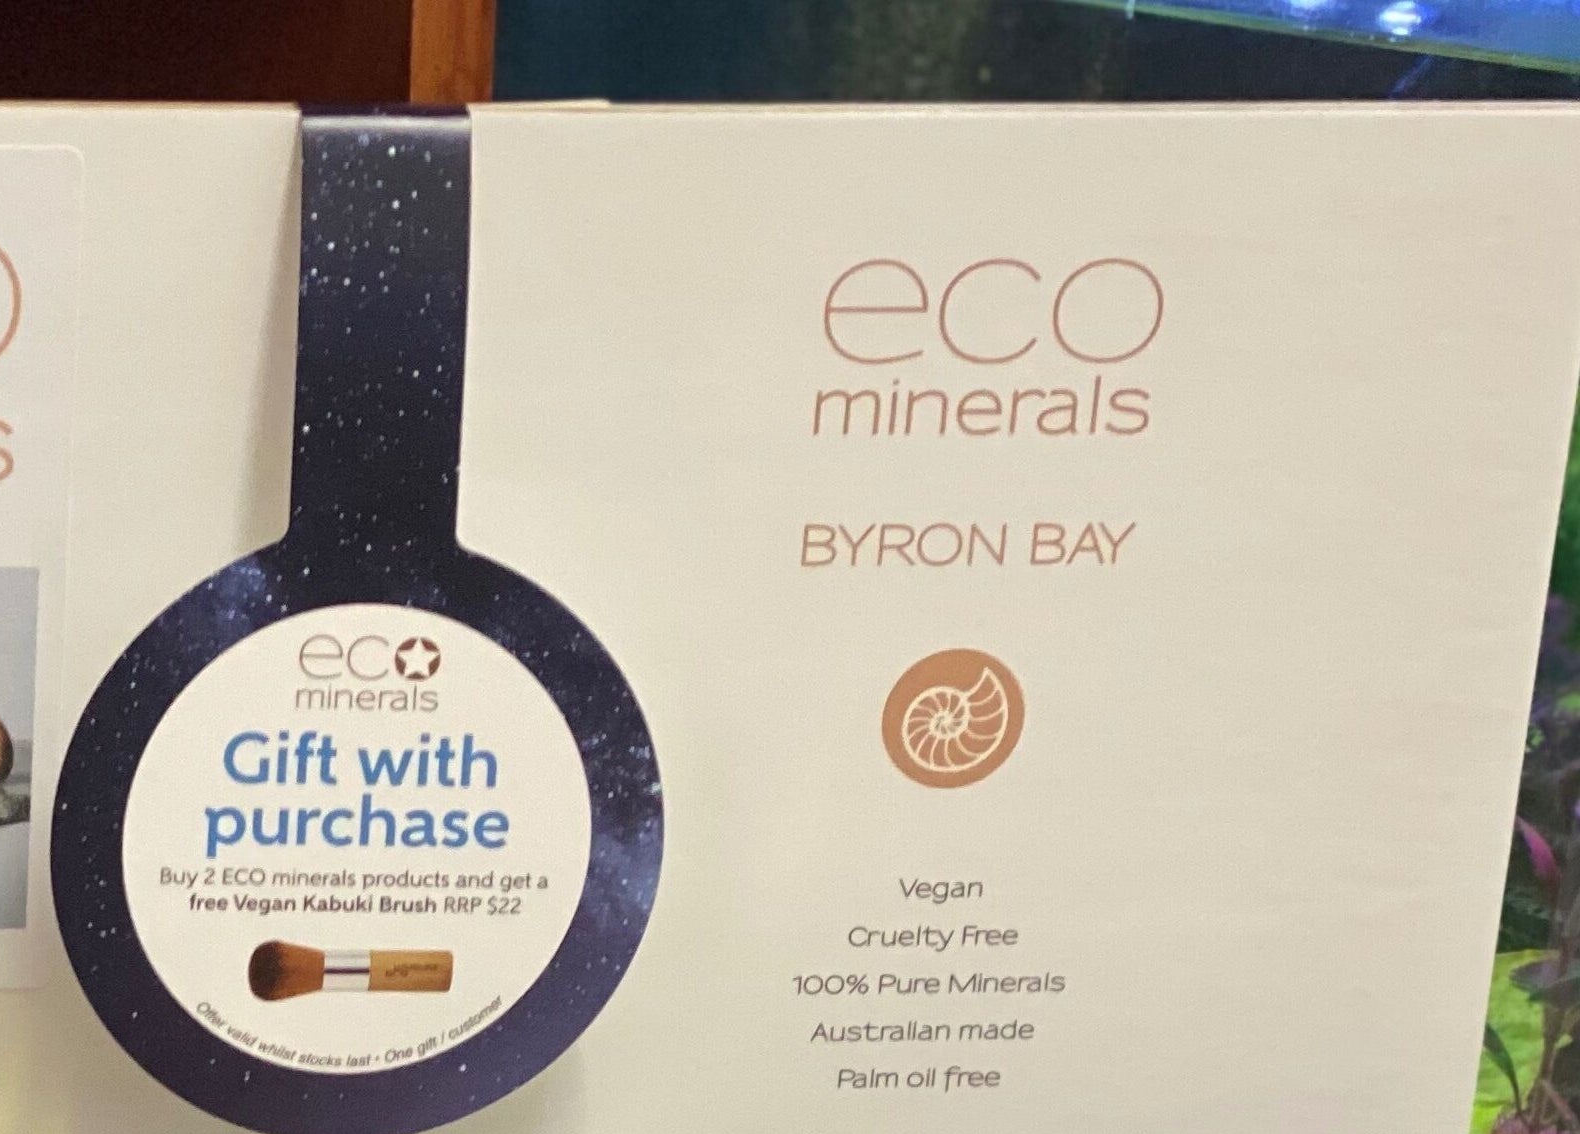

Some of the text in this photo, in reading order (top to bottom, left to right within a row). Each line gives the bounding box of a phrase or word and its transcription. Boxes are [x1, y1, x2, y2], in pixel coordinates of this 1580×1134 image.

[823, 258, 1164, 366] eco
[813, 375, 1150, 437] minerals
[801, 521, 1136, 568] BYRON BAY
[295, 684, 439, 713] minerals
[223, 730, 497, 788] Gift with
[205, 793, 509, 859] purchase
[160, 867, 548, 894] Buy 2 ECO minerals products and get a
[899, 878, 983, 905] Vegan
[190, 893, 521, 916] free Vegan Kabuki Brush RRP $22
[848, 925, 1018, 953] Cruelty Free
[793, 972, 1065, 996] 100% Pure Minerals
[196, 995, 503, 1067] Offer valid whilst stocks last One gift customer
[810, 1019, 1034, 1043] Australian made
[837, 1065, 1001, 1093] Palm oil free
